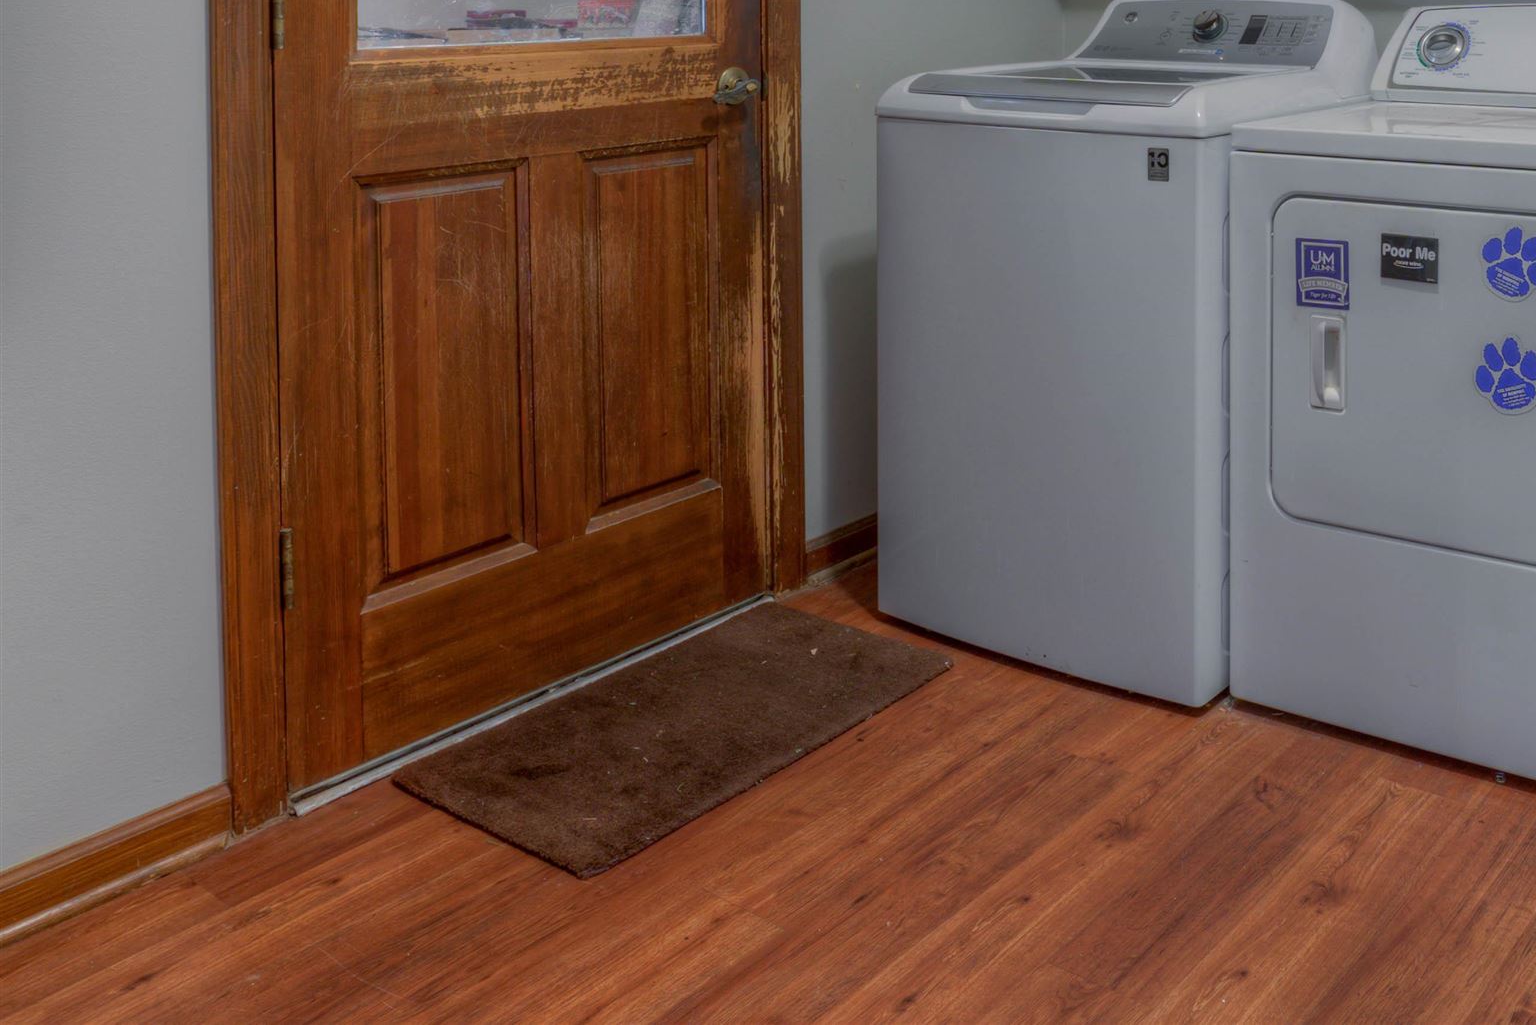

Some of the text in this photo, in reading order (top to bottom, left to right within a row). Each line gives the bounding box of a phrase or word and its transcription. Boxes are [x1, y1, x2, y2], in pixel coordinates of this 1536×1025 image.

[1149, 151, 1169, 168] 10
[1382, 242, 1436, 261] Poor Me
